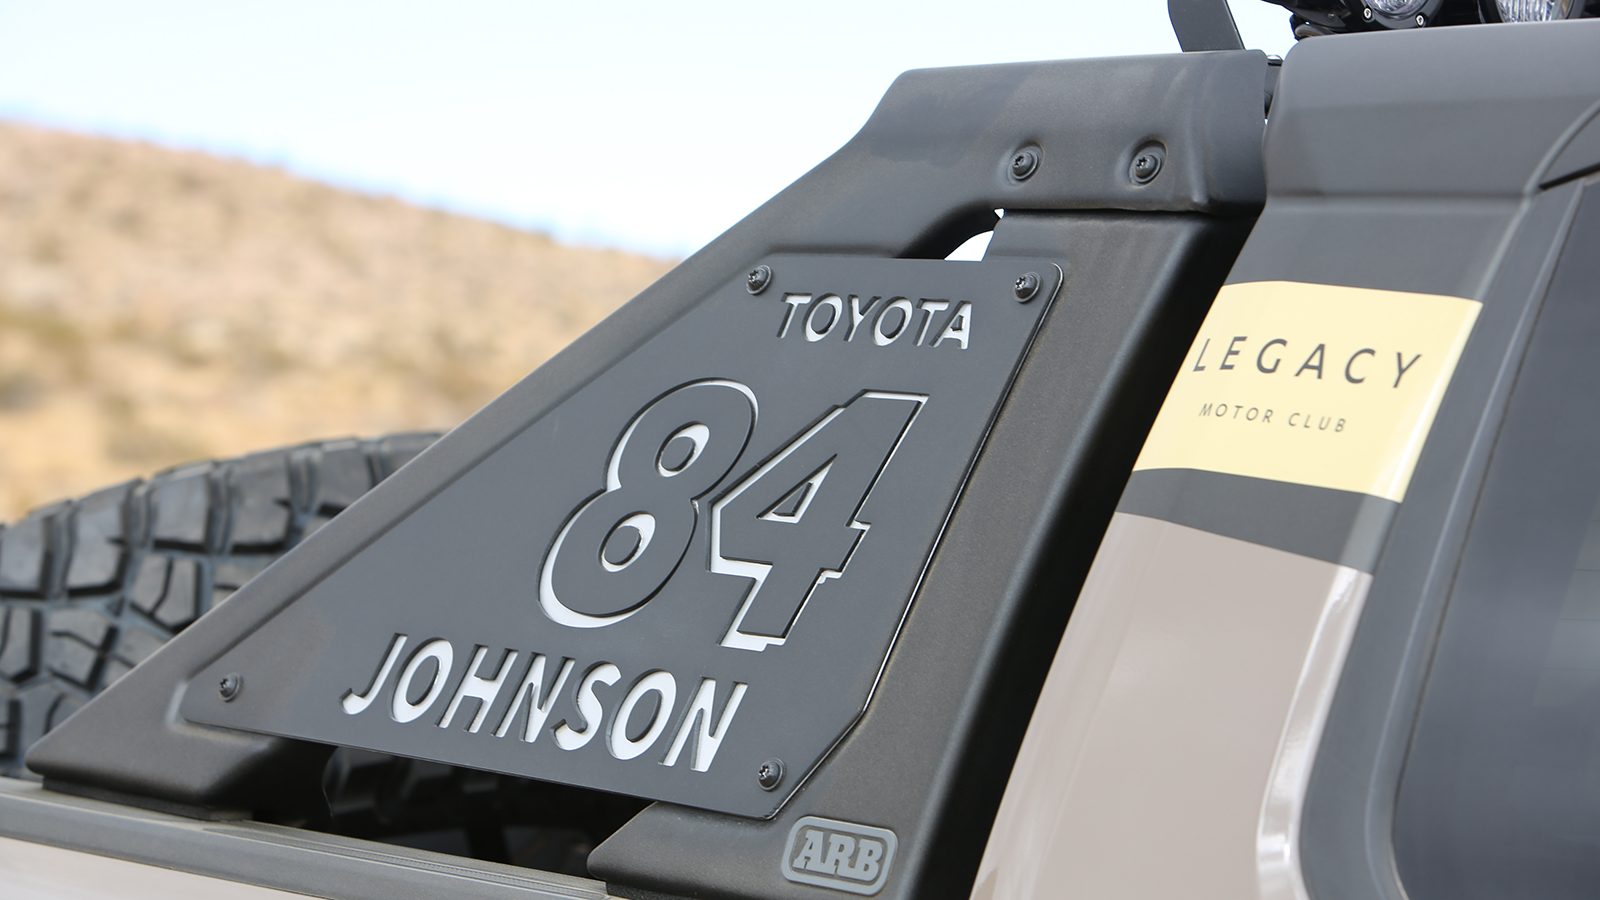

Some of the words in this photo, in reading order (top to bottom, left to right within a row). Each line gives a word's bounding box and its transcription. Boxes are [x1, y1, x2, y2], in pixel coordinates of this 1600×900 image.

[777, 292, 972, 350] TOYOTA
[1193, 335, 1422, 389] LEGACY
[1198, 403, 1273, 424] MOTOR
[1288, 412, 1347, 433] CLUB
[538, 376, 929, 652] 84
[342, 633, 748, 772] JOHNSON
[793, 829, 884, 882] ARB
